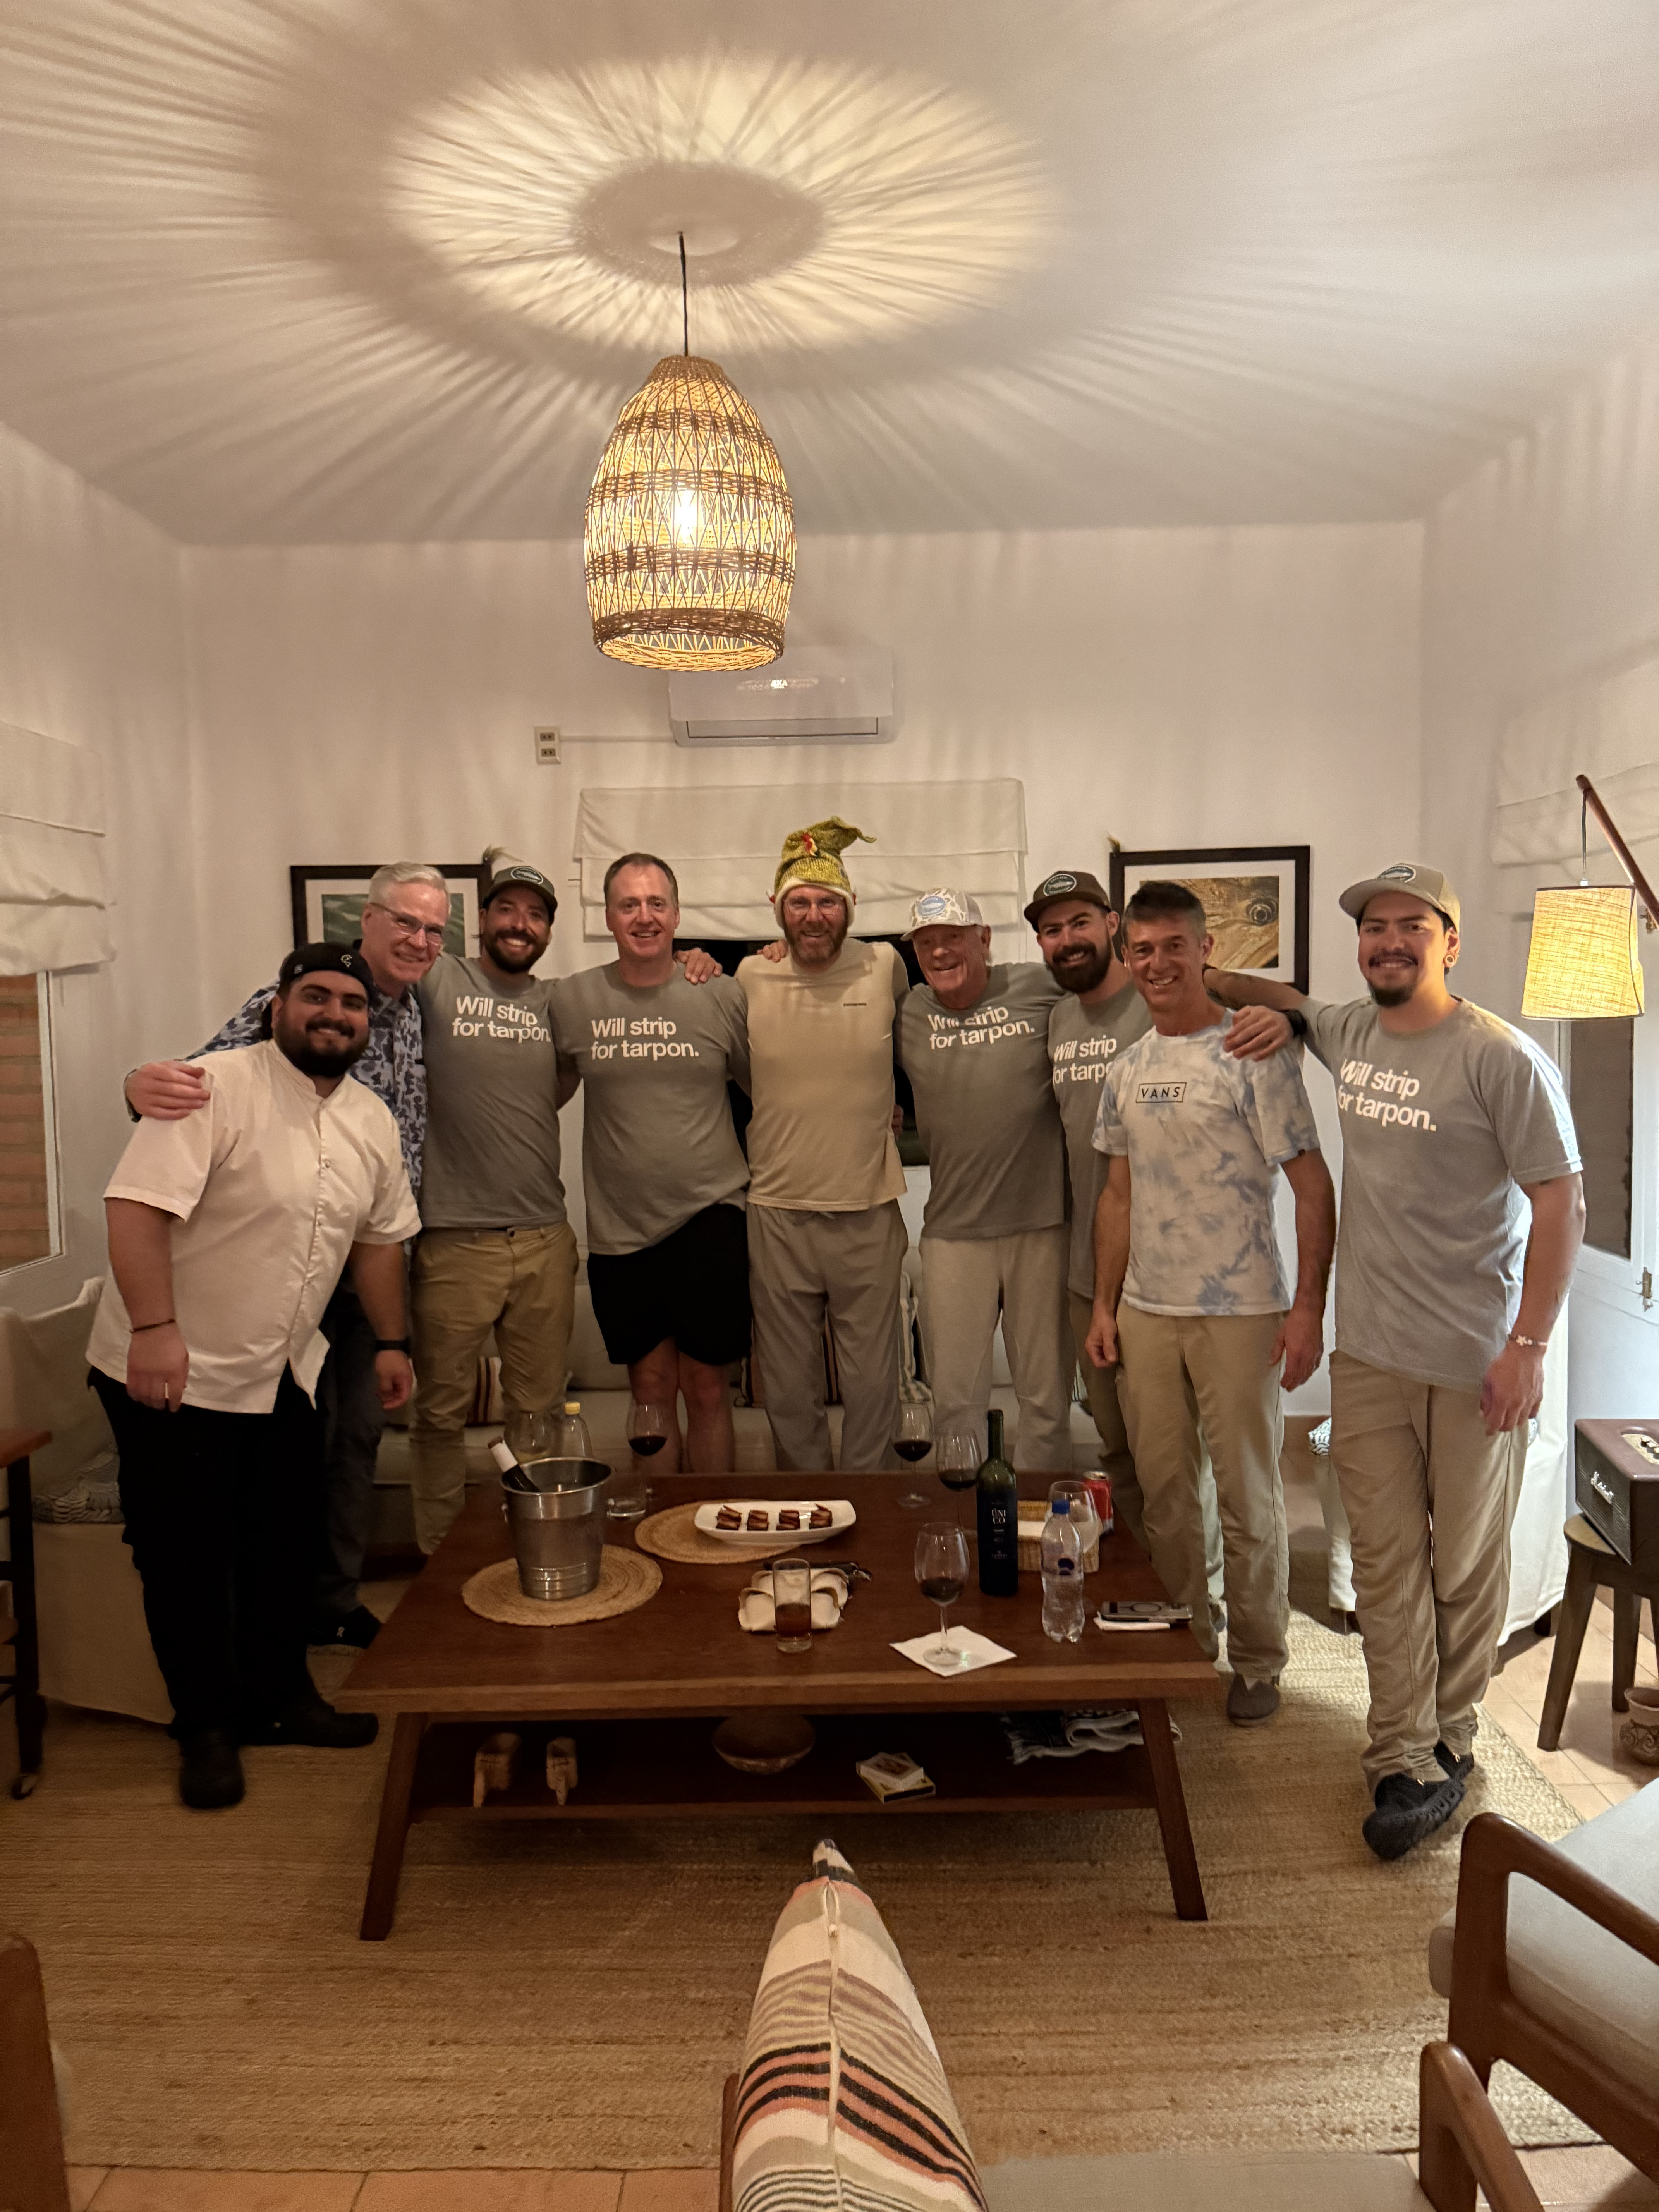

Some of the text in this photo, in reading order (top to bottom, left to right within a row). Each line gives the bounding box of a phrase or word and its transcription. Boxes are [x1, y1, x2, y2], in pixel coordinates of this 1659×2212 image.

[456, 996, 538, 1027] Will strip
[452, 1017, 551, 1043] for tarpon.
[591, 1017, 677, 1039] Will strip
[929, 1020, 1035, 1050] for tarpon.
[591, 1040, 699, 1061] for tarpon.
[1054, 1034, 1117, 1062] Will strip
[1142, 1087, 1180, 1099] VANS
[1340, 1058, 1420, 1101] Will strip
[1355, 1092, 1437, 1132] tarpon.
